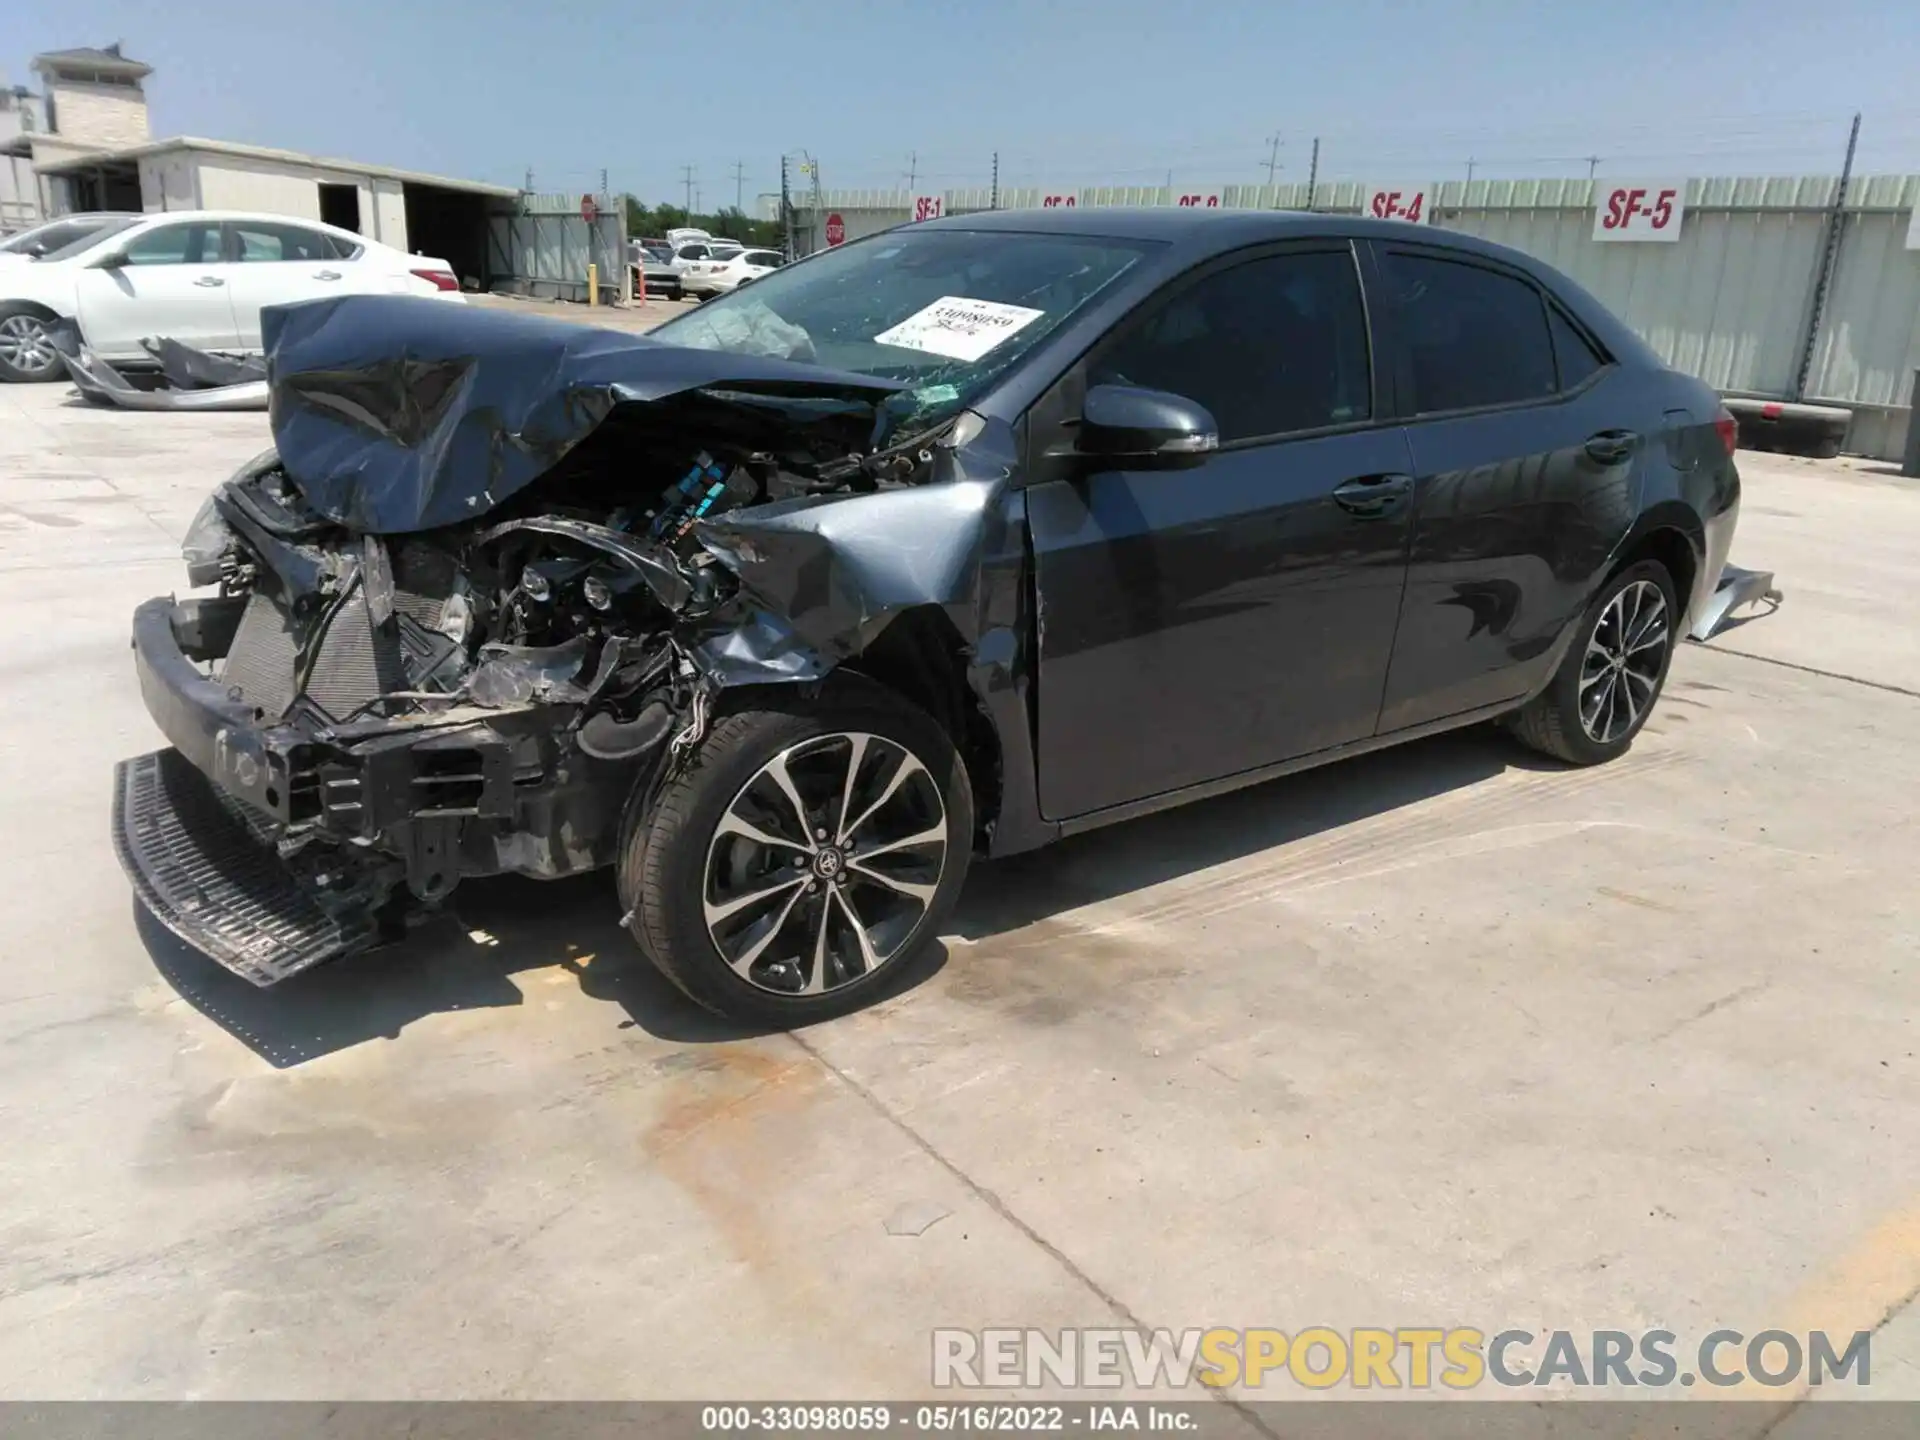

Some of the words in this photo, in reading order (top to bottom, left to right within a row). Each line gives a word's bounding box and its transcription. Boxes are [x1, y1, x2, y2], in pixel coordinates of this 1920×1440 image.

[916, 196, 941, 222] SF-1
[1373, 191, 1424, 223] SF-4
[1603, 189, 1677, 229] SF-5
